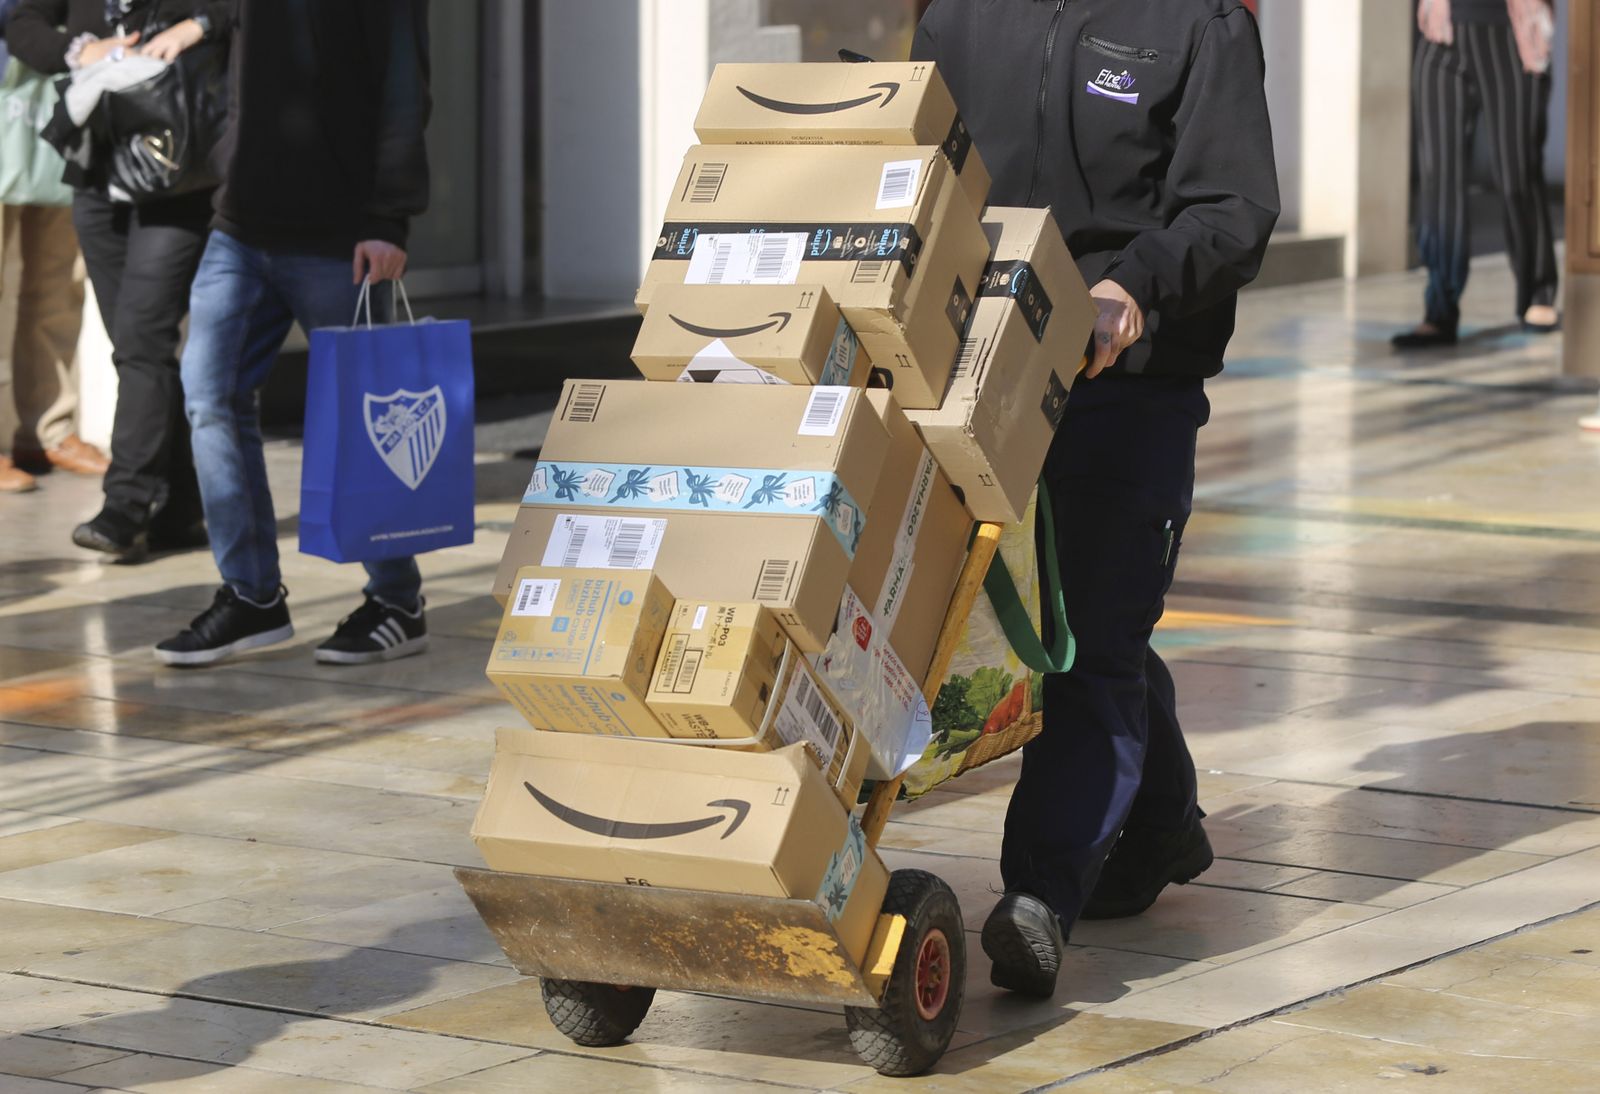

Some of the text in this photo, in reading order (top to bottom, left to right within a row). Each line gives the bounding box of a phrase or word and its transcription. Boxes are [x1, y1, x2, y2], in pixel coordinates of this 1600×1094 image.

[677, 228, 691, 255] prime
[810, 228, 825, 256] prime
[877, 228, 891, 256] prime
[576, 579, 593, 616] bizhub
[587, 580, 605, 616] bizhub
[718, 606, 737, 647] WB-P03
[573, 685, 612, 722] bizhub
[694, 714, 719, 739] WB-P0
